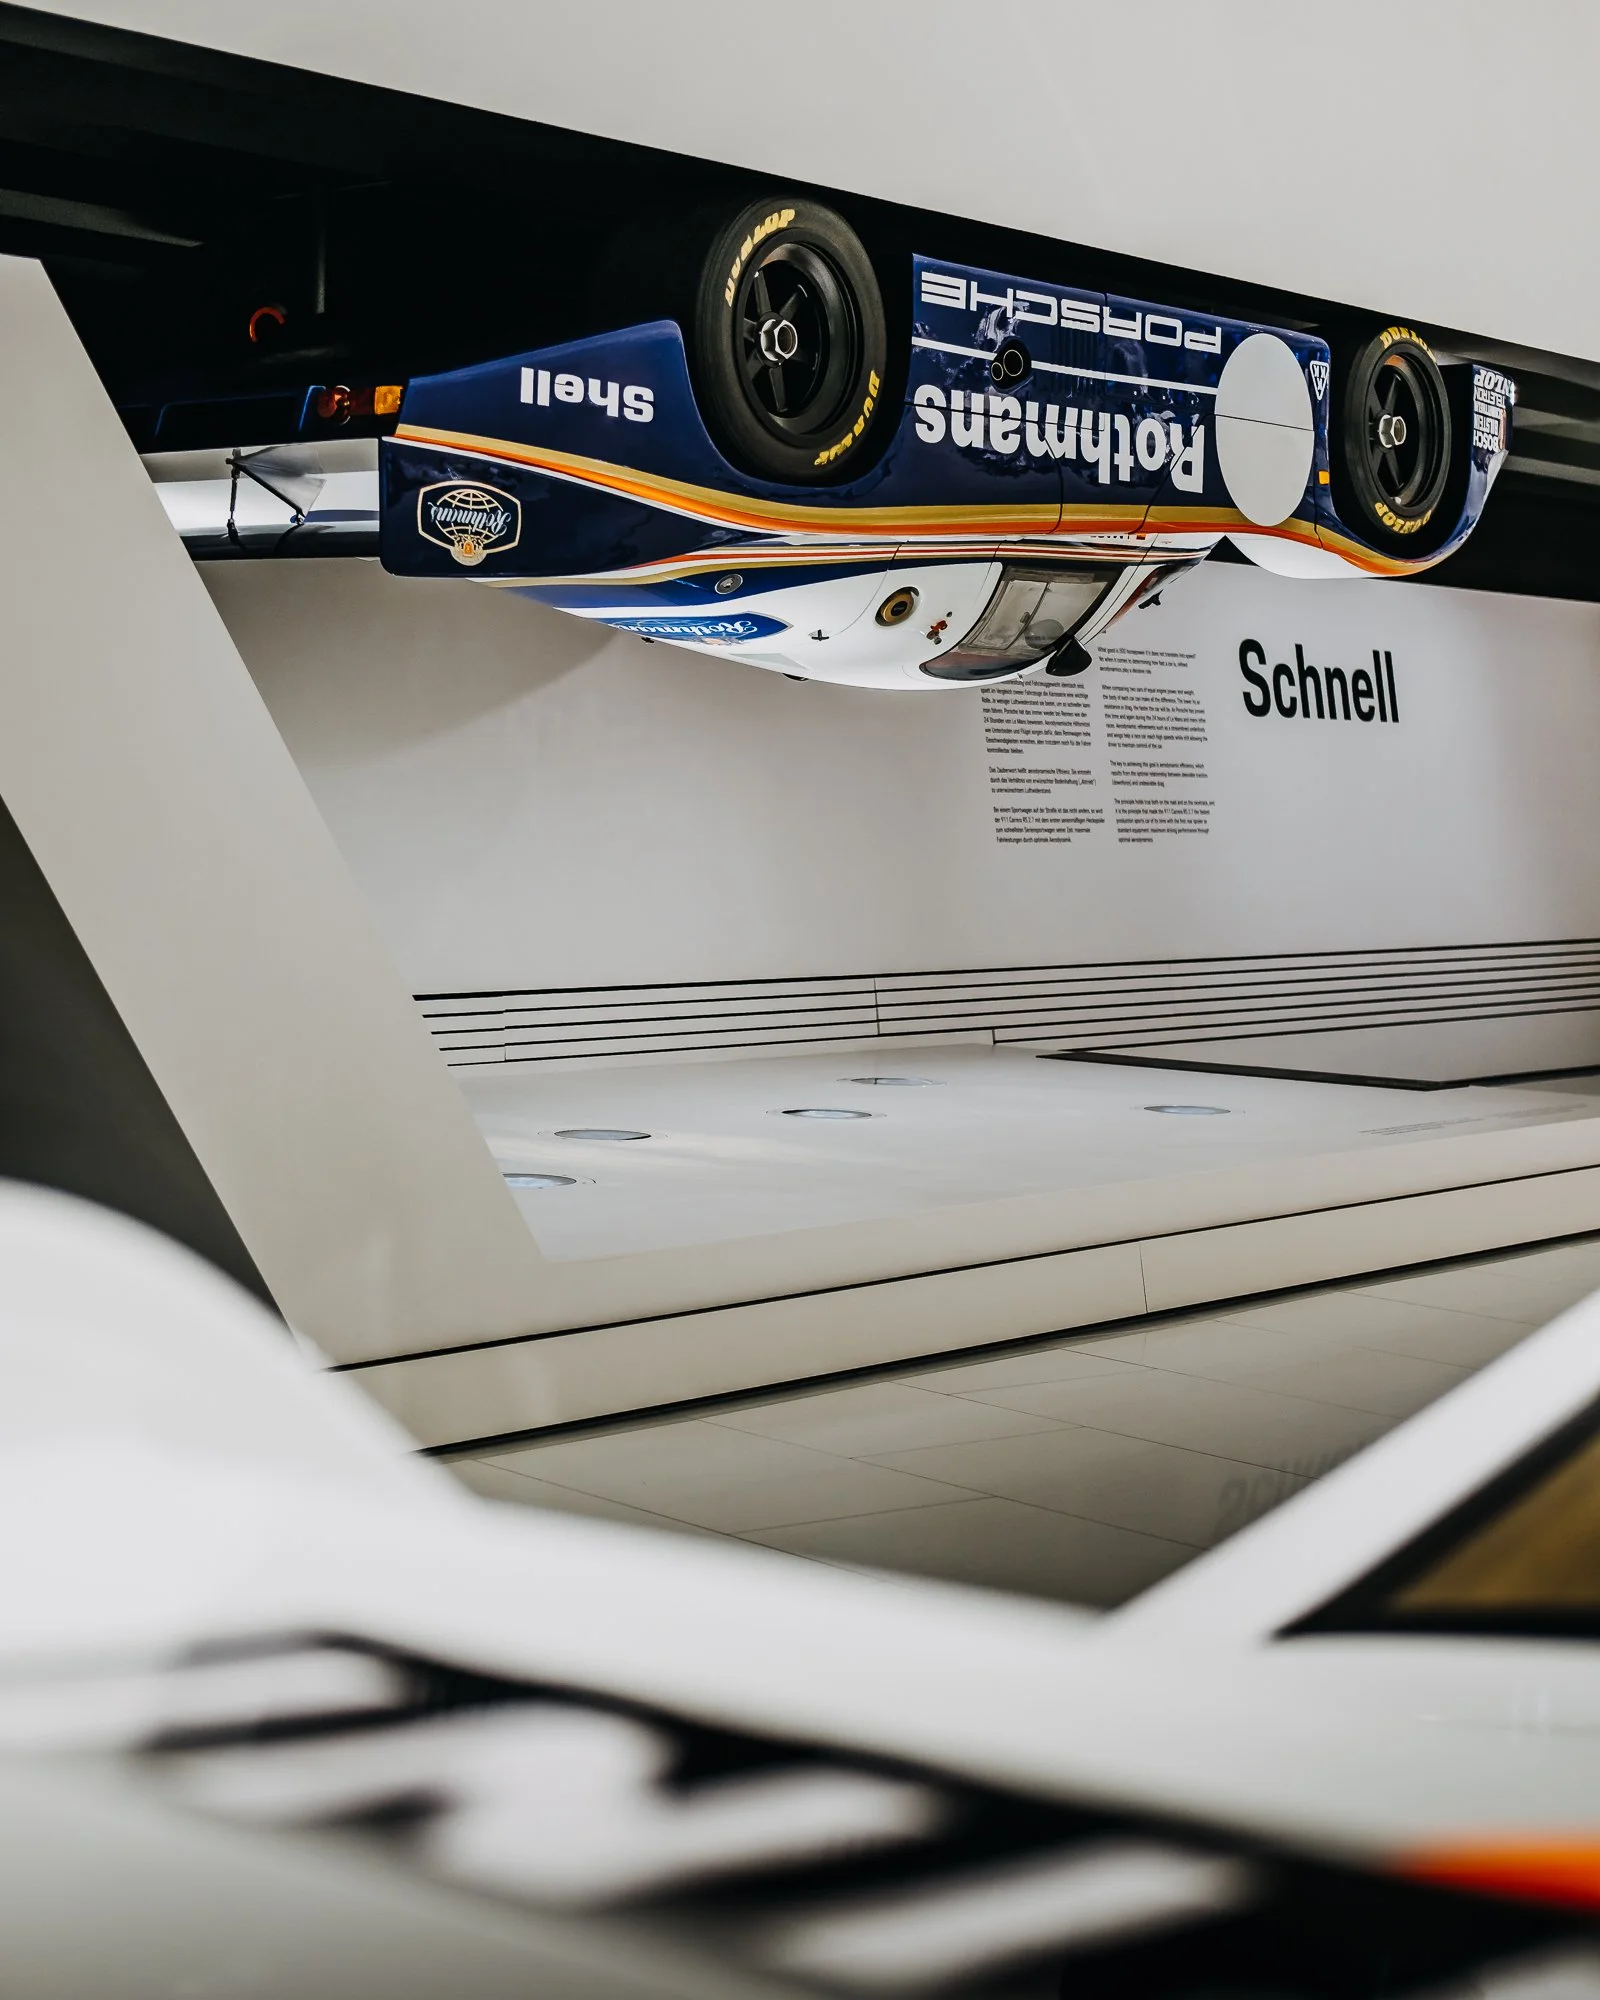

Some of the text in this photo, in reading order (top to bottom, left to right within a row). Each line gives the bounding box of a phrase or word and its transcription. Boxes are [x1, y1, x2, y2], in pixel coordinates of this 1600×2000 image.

[921, 271, 1222, 355] PORSCHE
[519, 367, 655, 423] Shell
[914, 384, 1205, 494] Rothmans
[1473, 429, 1501, 453] BOSCH
[427, 502, 512, 537] Rothmans
[1374, 502, 1432, 534] DUNLOP
[1239, 638, 1399, 723] Schnell
